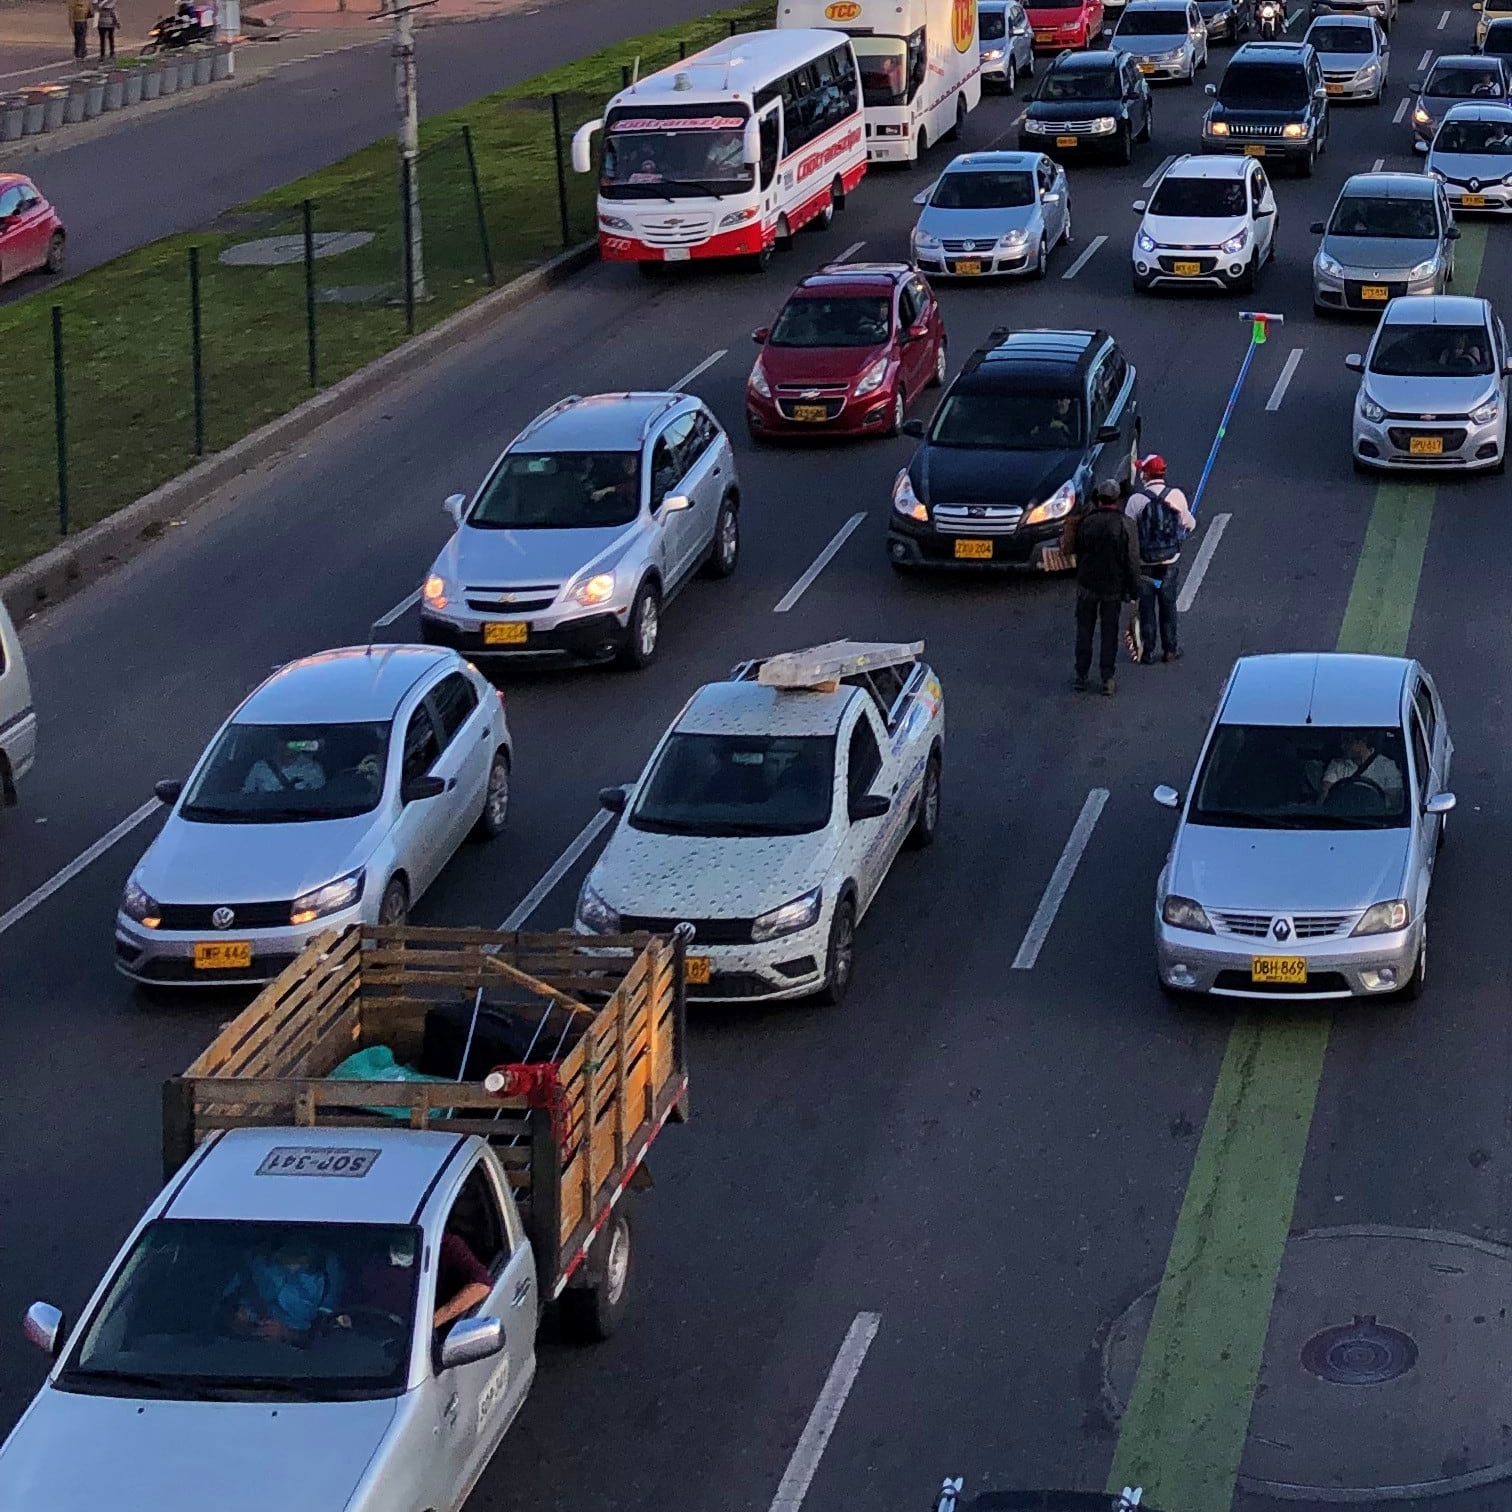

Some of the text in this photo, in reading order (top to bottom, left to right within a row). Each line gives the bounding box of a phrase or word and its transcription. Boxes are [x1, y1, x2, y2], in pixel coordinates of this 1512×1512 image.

[830, 4, 857, 20] TCC
[1254, 960, 1305, 976] DBH 869
